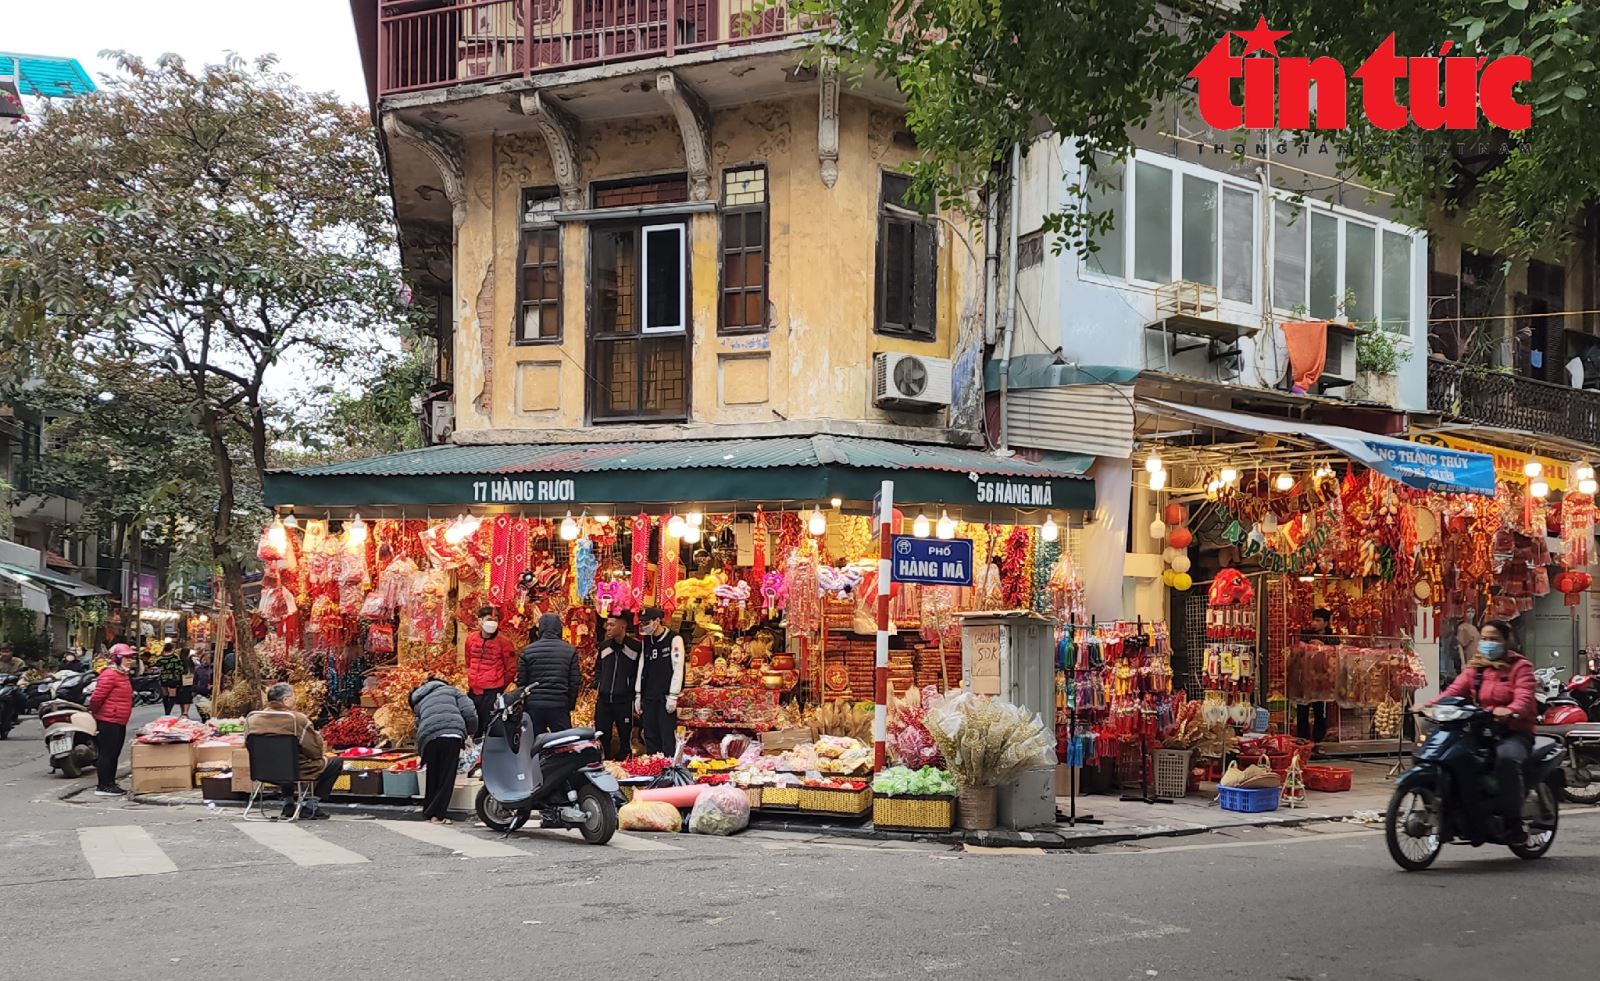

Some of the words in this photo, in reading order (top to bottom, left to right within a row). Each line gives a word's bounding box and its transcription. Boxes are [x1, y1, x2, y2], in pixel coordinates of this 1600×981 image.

[473, 481, 487, 501] 17
[491, 477, 534, 501] HÀNG
[977, 481, 994, 503] 56
[995, 479, 1030, 505] HÀNG
[1031, 481, 1052, 505] MÃ
[928, 545, 951, 556] PHỐ
[900, 557, 938, 577] HÀNG
[943, 560, 964, 579] MÃ
